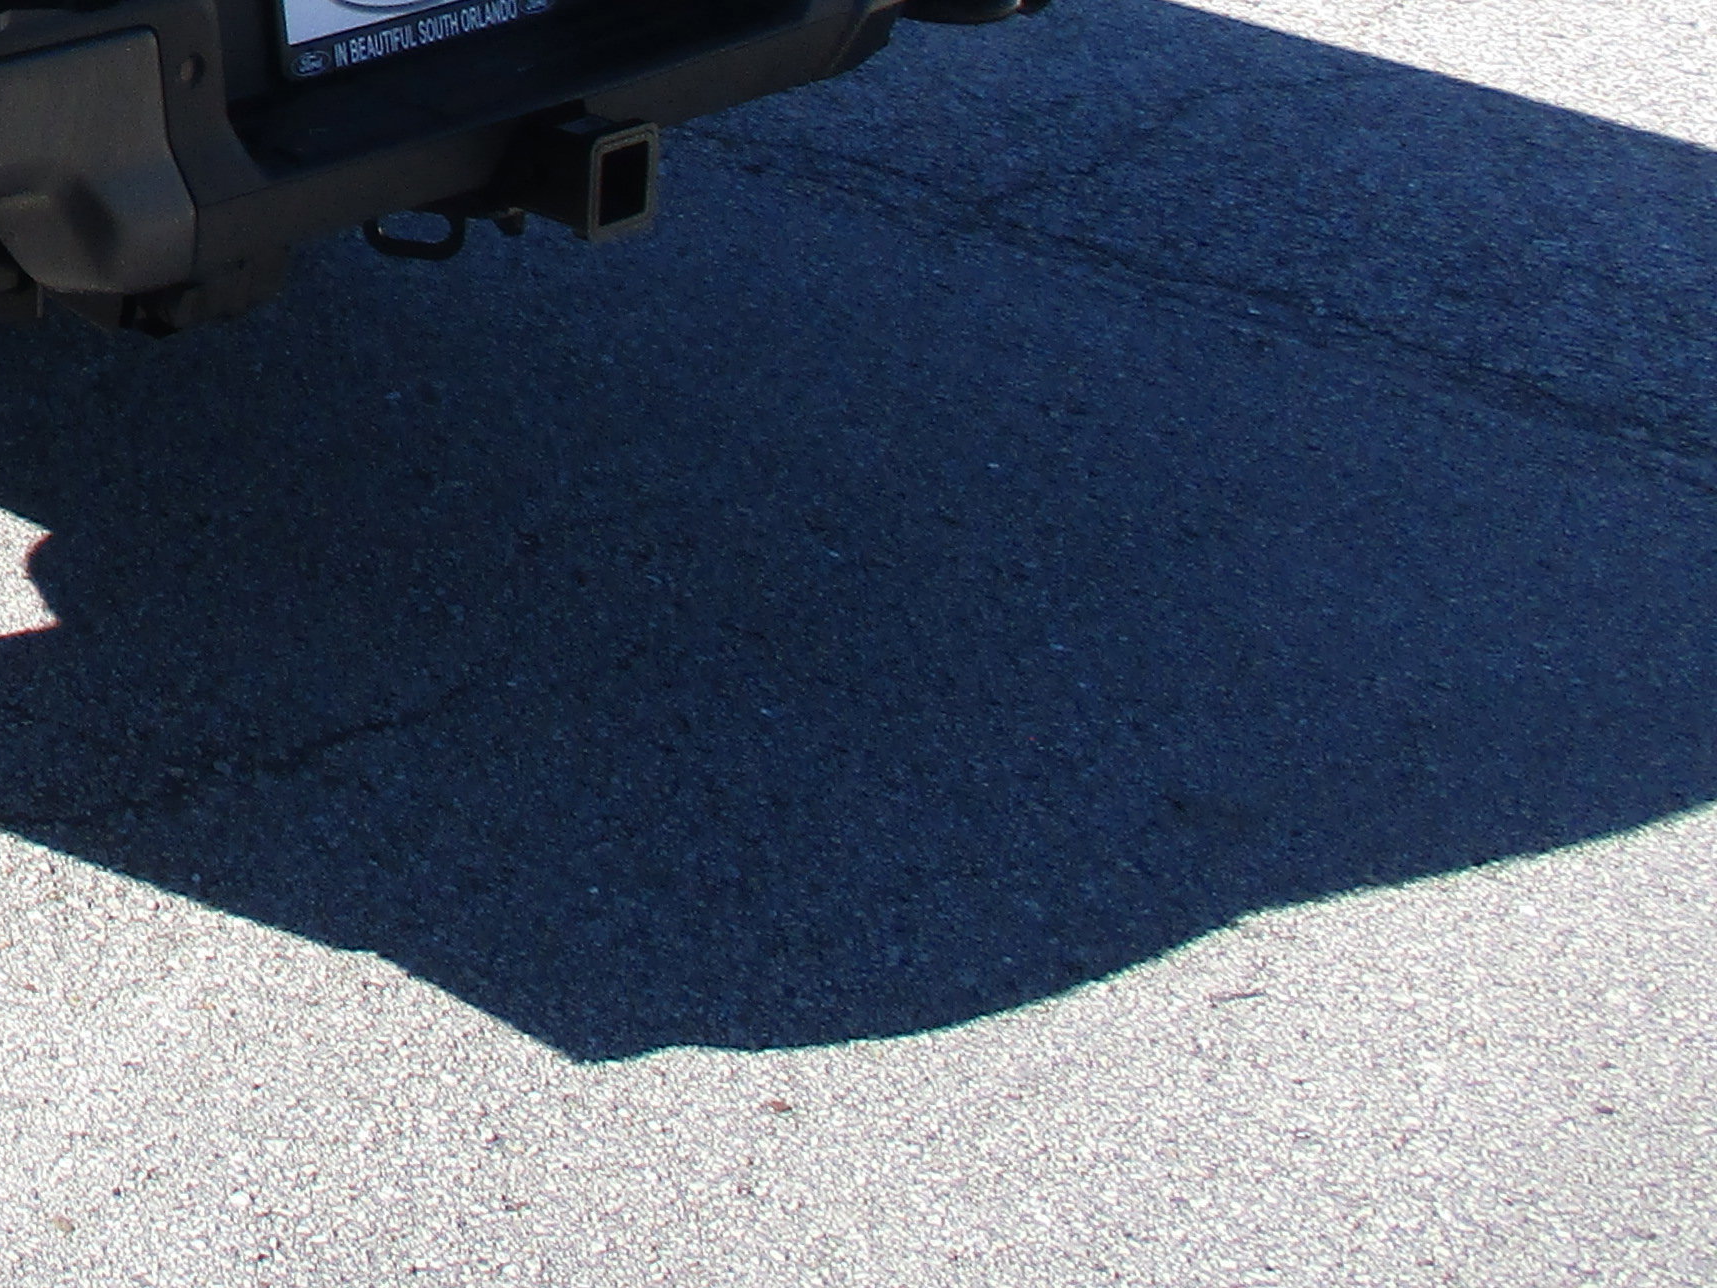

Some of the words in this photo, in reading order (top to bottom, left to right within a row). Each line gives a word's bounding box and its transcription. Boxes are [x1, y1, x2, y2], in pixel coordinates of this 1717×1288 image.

[333, 43, 349, 67] IN
[350, 26, 417, 63] BEAUTIFUL
[418, 14, 459, 44] SOUTH
